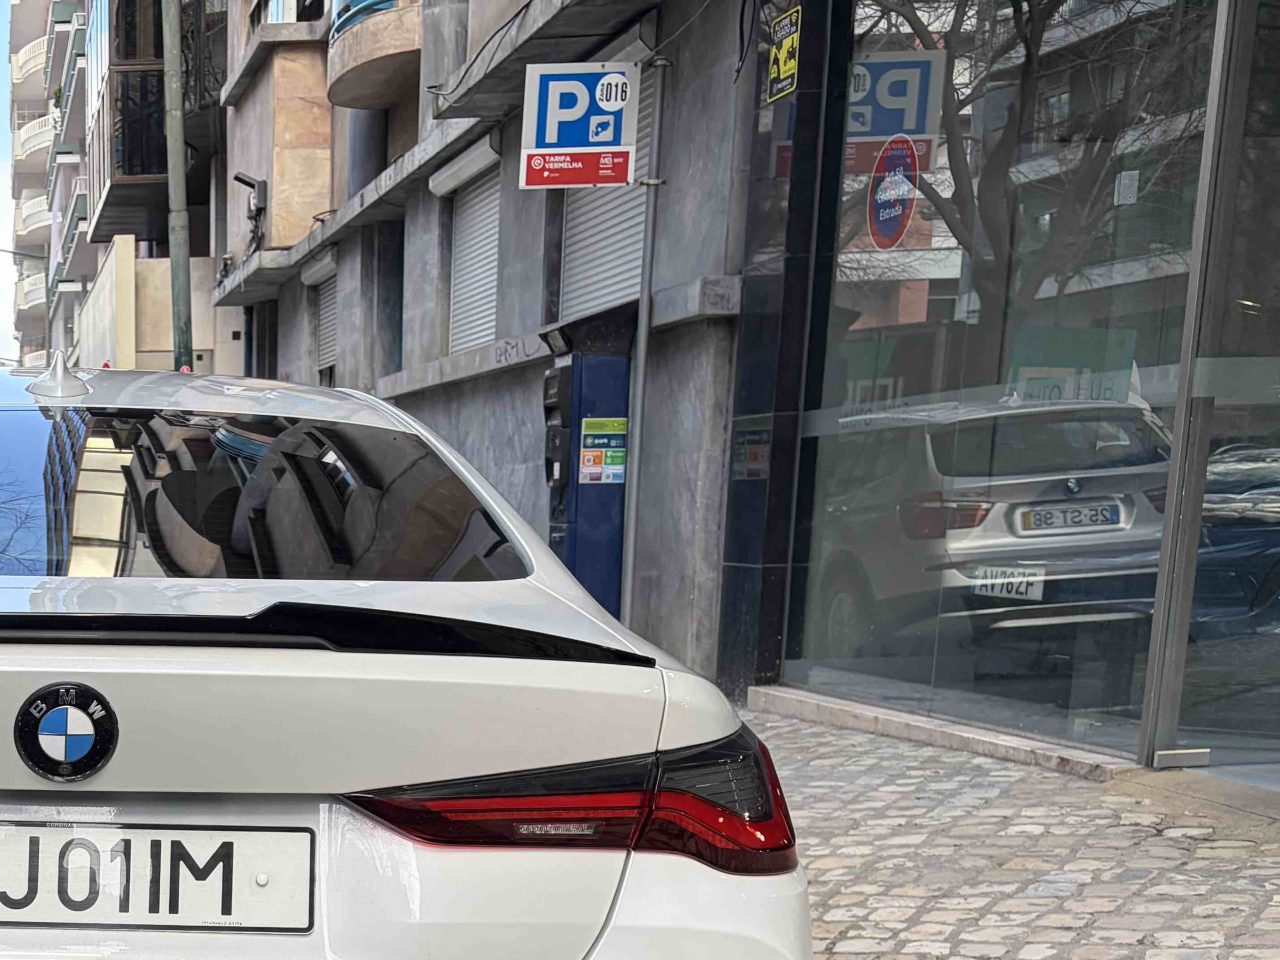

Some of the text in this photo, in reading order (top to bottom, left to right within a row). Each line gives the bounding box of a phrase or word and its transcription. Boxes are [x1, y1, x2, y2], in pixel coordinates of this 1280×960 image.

[605, 82, 628, 102] 016
[545, 80, 590, 144] P
[545, 161, 583, 169] VERMELHA
[879, 203, 902, 220] Estrada
